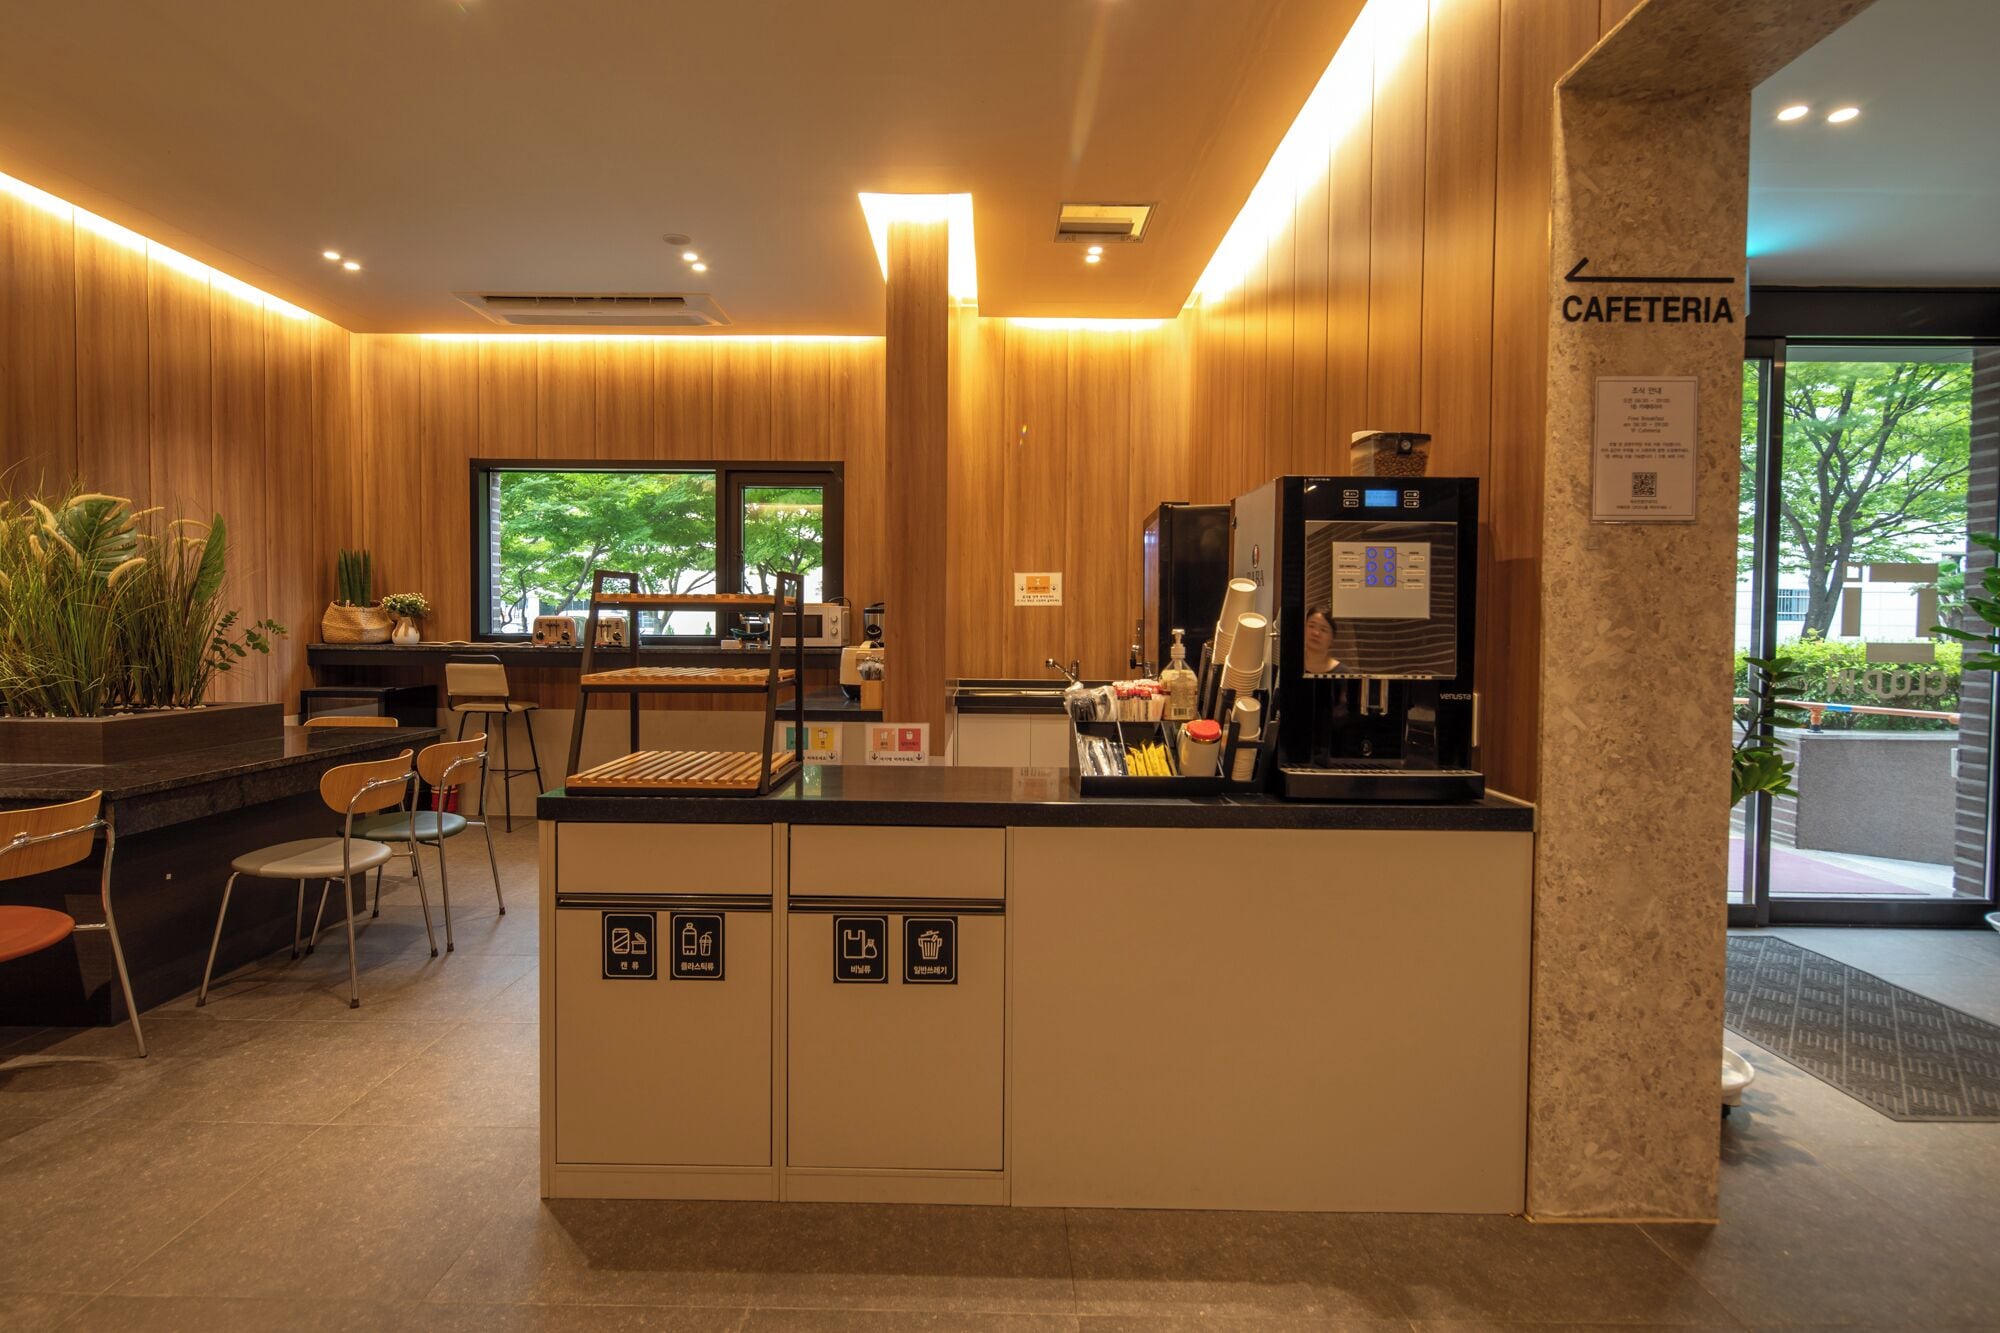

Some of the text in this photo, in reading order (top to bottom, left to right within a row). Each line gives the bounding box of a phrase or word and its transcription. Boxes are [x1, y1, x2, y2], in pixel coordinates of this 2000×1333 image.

[1562, 295, 1734, 323] CAFETERIA
[680, 961, 715, 971] 플라스틱류
[850, 964, 871, 974] 비닐류
[913, 965, 948, 975] 일반쓰레기
